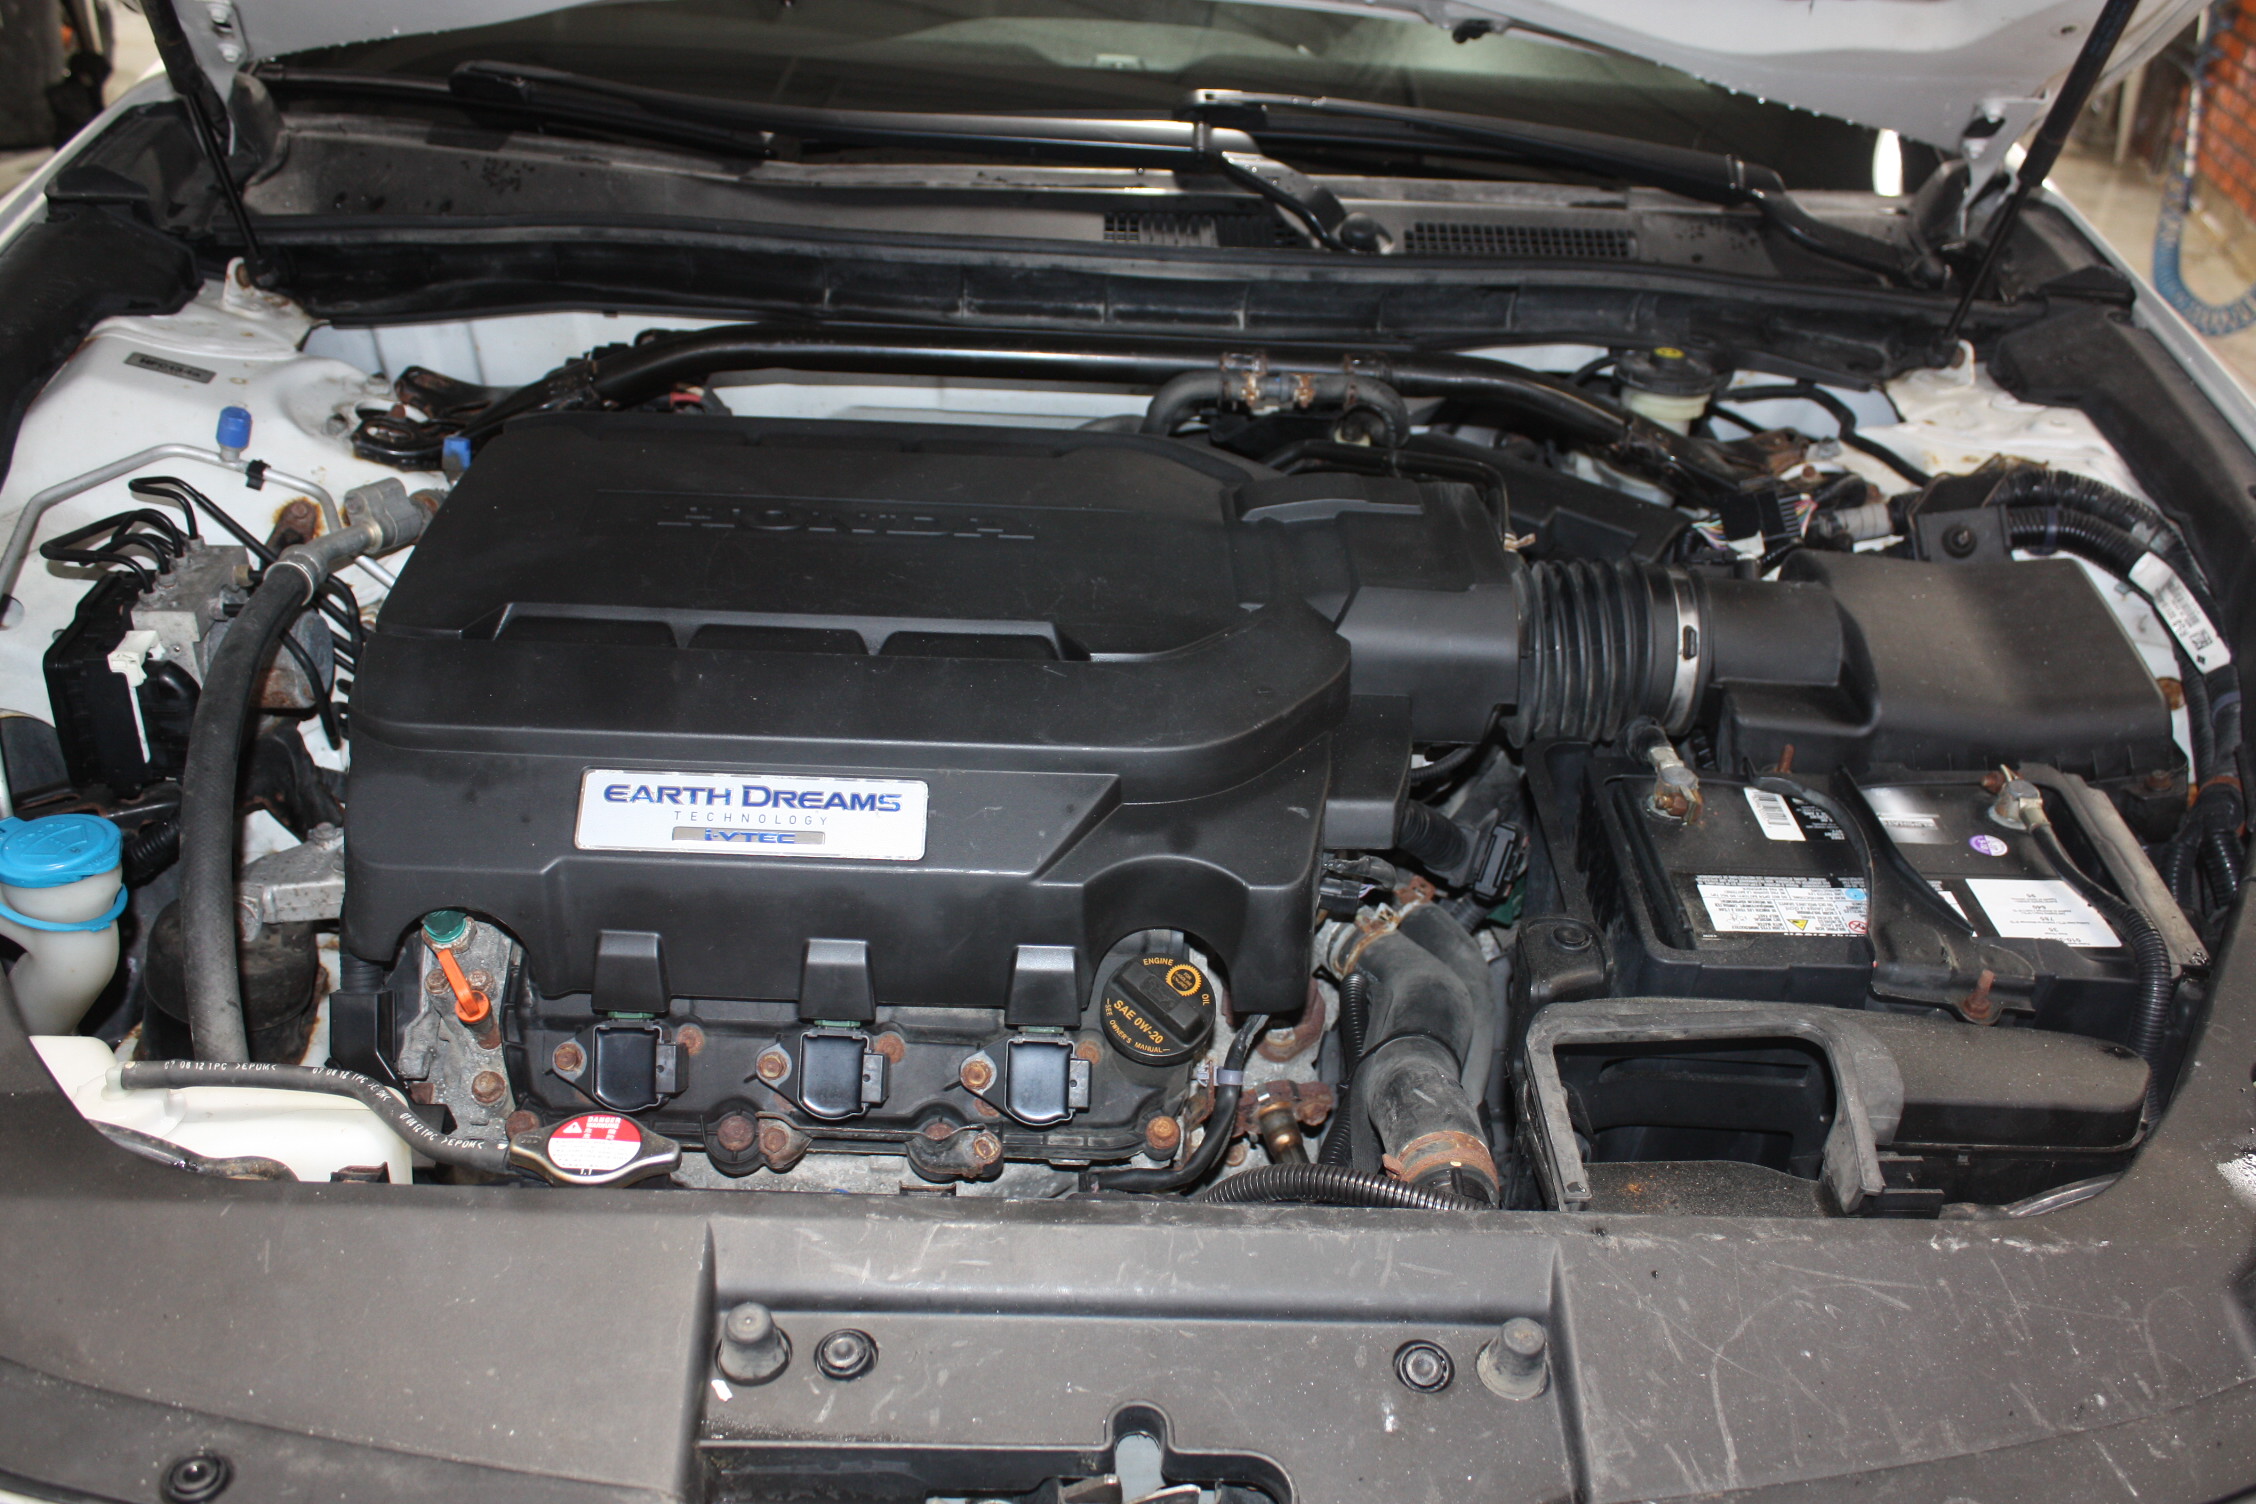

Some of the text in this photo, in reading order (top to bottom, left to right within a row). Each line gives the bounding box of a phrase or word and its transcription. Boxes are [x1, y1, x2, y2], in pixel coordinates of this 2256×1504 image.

[603, 783, 902, 812] EARTH DREAMS
[674, 810, 829, 826] TECHNOLOGY
[1142, 957, 1174, 966] ENGINE
[1201, 993, 1210, 1006] OIL
[1113, 999, 1164, 1044] SAE 0W-20
[1109, 1019, 1132, 1044] OWNER'S
[585, 1122, 620, 1130] WARNING
[587, 1116, 622, 1124] DANGER
